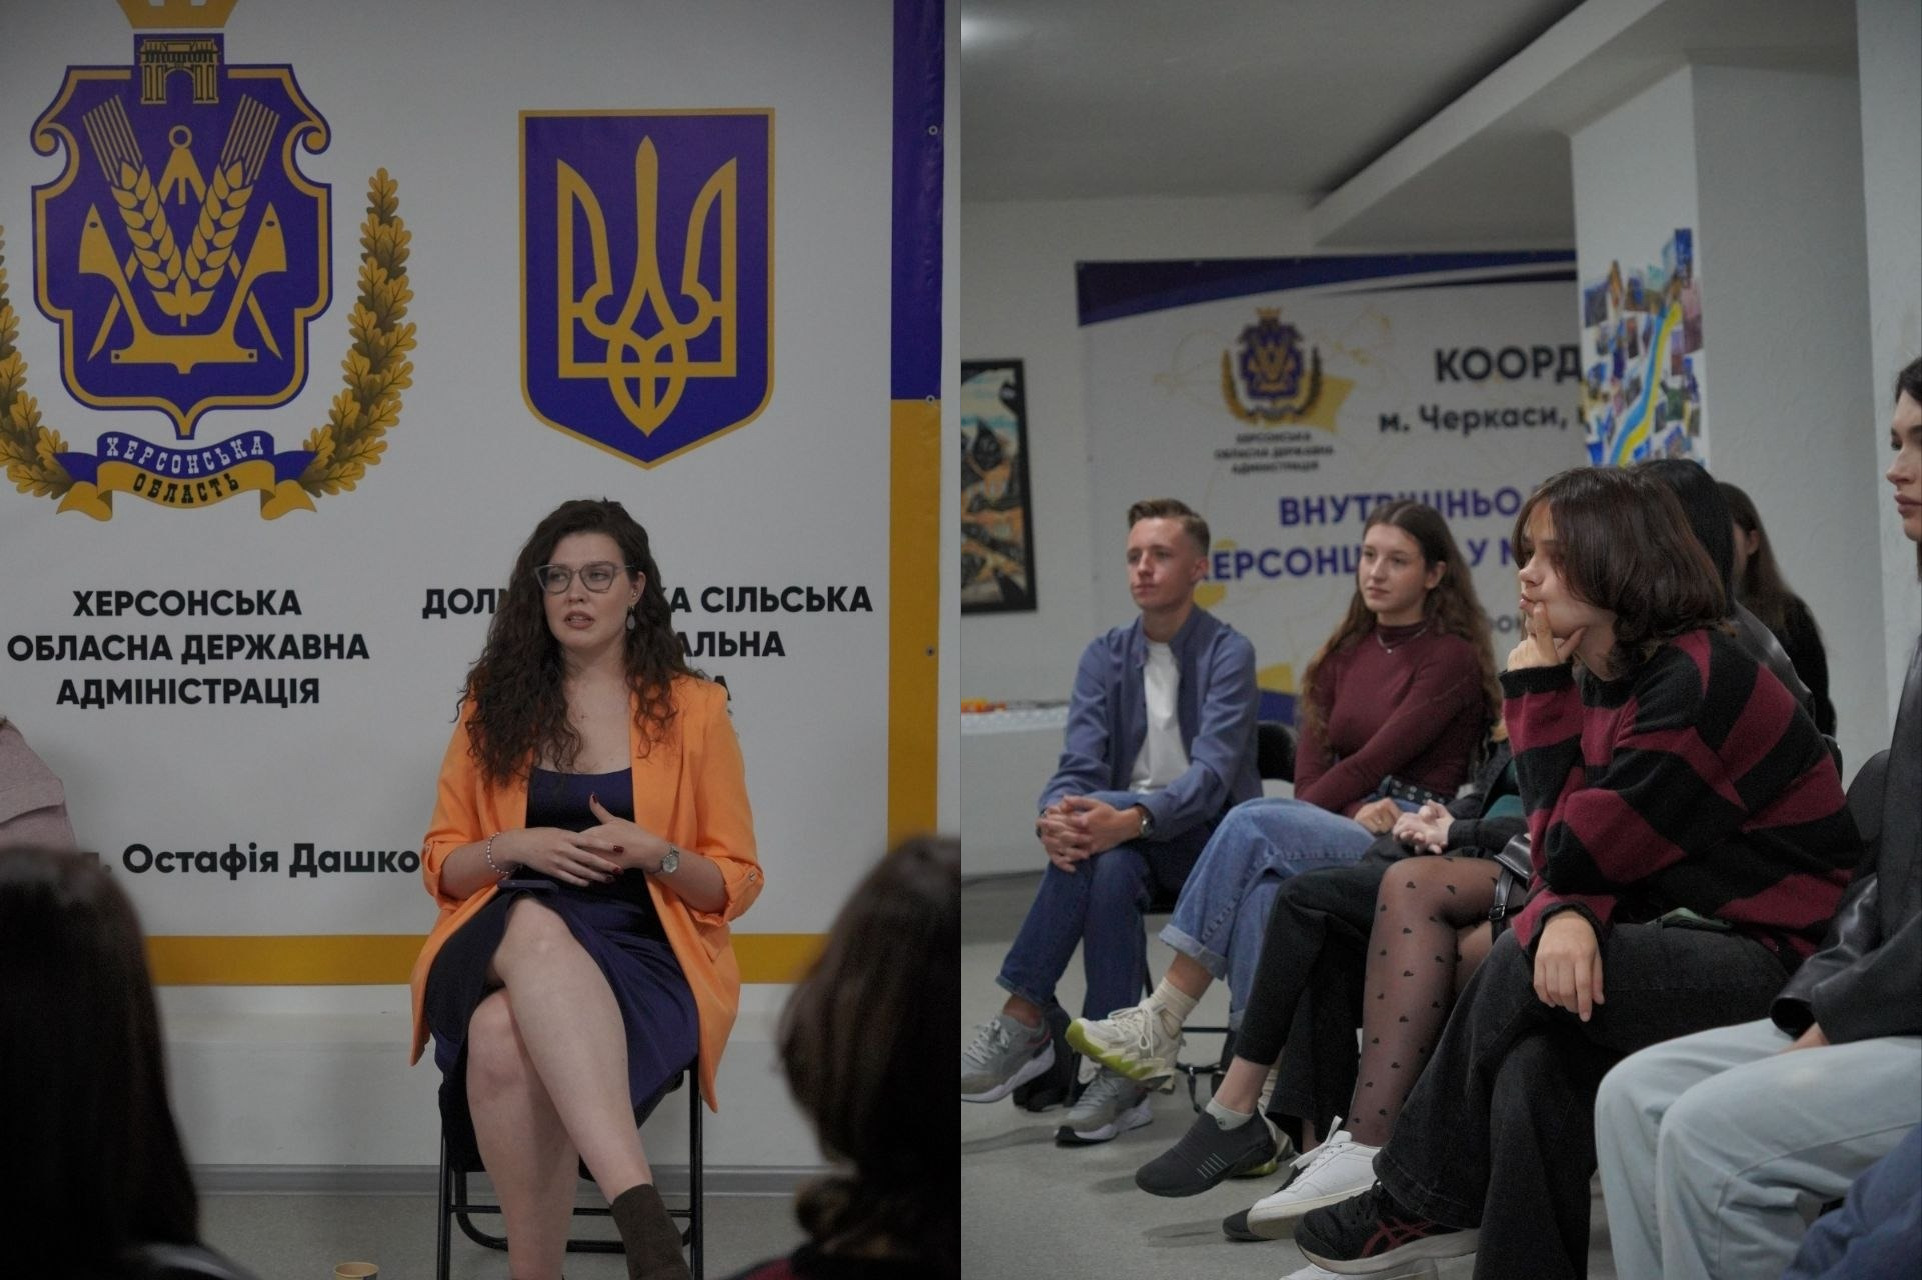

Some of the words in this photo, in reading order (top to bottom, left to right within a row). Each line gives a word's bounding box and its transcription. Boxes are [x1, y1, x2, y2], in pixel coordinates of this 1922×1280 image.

[1434, 344, 1582, 382] КООРД
[1418, 403, 1568, 437] Черкаси,
[106, 435, 264, 475] ХЕРСОНСЬКА
[133, 473, 239, 504] ОБЛАСТЬ
[1279, 487, 1522, 527] ВНУТШНЬО
[1466, 538, 1490, 567] У
[73, 589, 302, 617] ХЕРСОНСЬКА
[700, 585, 874, 613] СІЛЬСЬКА
[7, 634, 174, 662] ОБЛАСНА
[181, 633, 371, 665] ДЕРЖАВНА
[56, 677, 320, 709] АДМІНІСТРАЦІЯ
[122, 842, 279, 881] Остафія
[289, 842, 420, 879] Дашко
